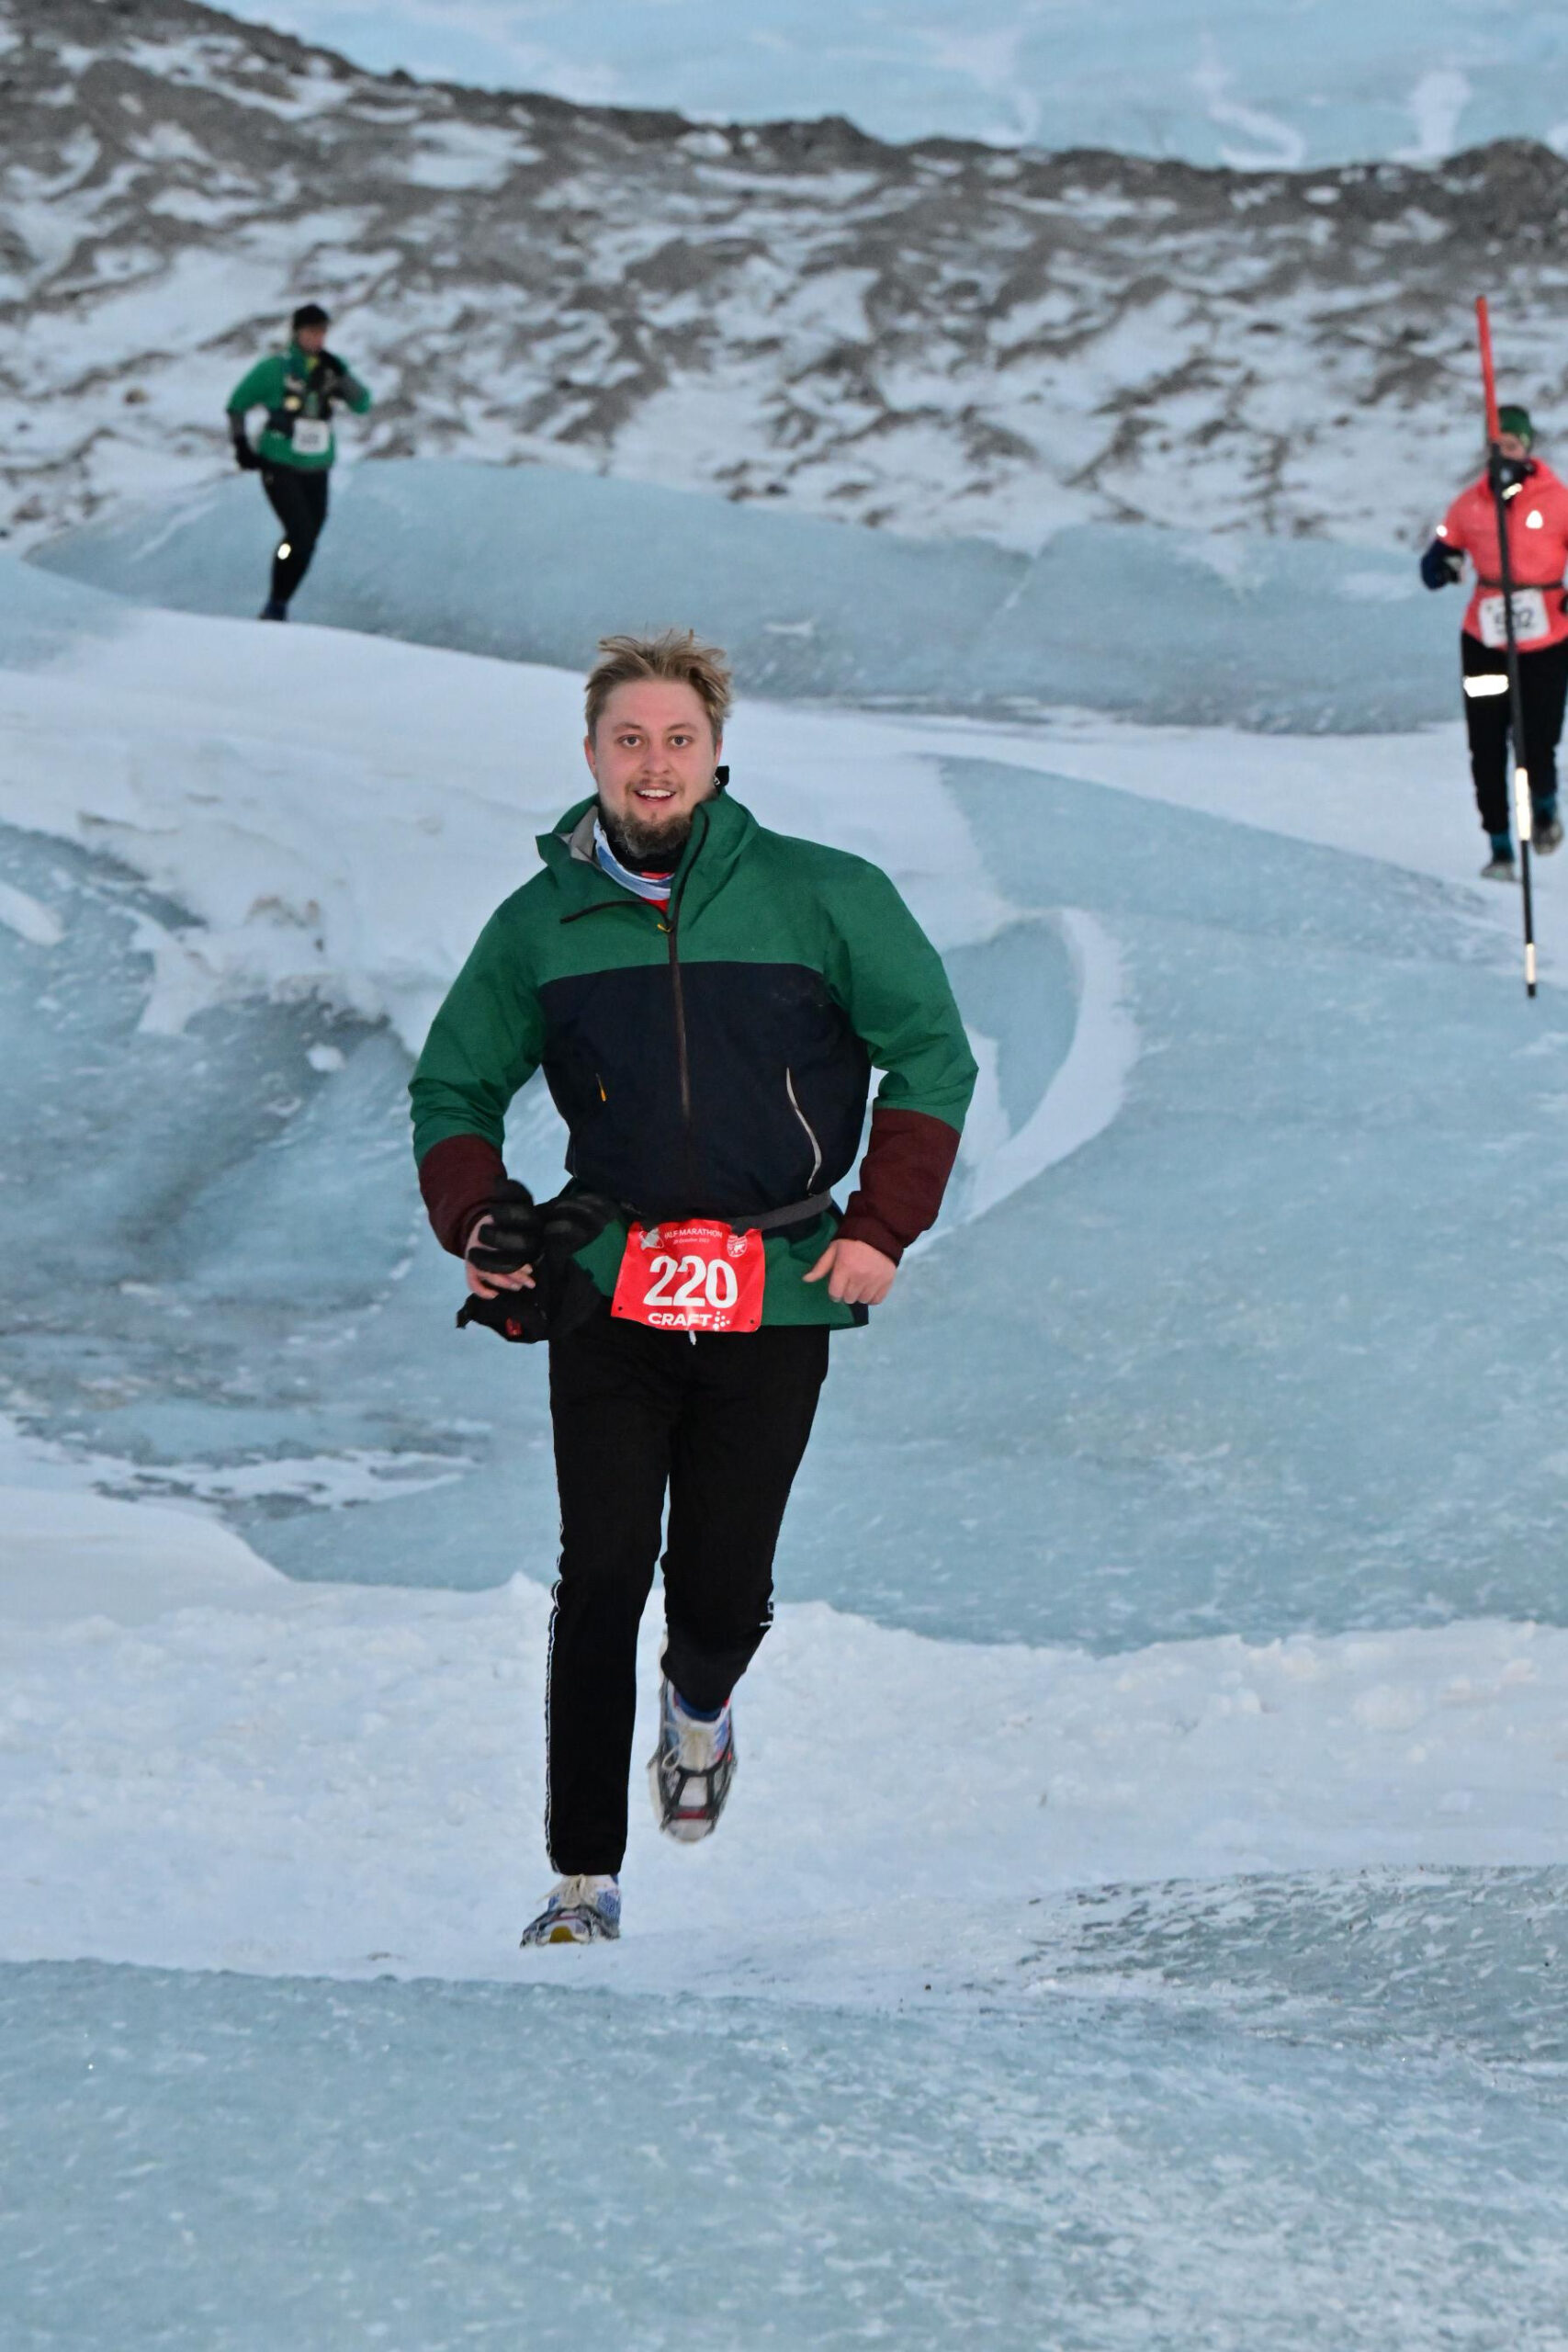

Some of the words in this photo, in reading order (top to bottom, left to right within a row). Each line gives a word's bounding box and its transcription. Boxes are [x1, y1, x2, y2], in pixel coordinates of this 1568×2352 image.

[679, 1228, 723, 1238] MARATHON
[643, 1255, 738, 1308] 220
[648, 1313, 712, 1327] CRAFT
